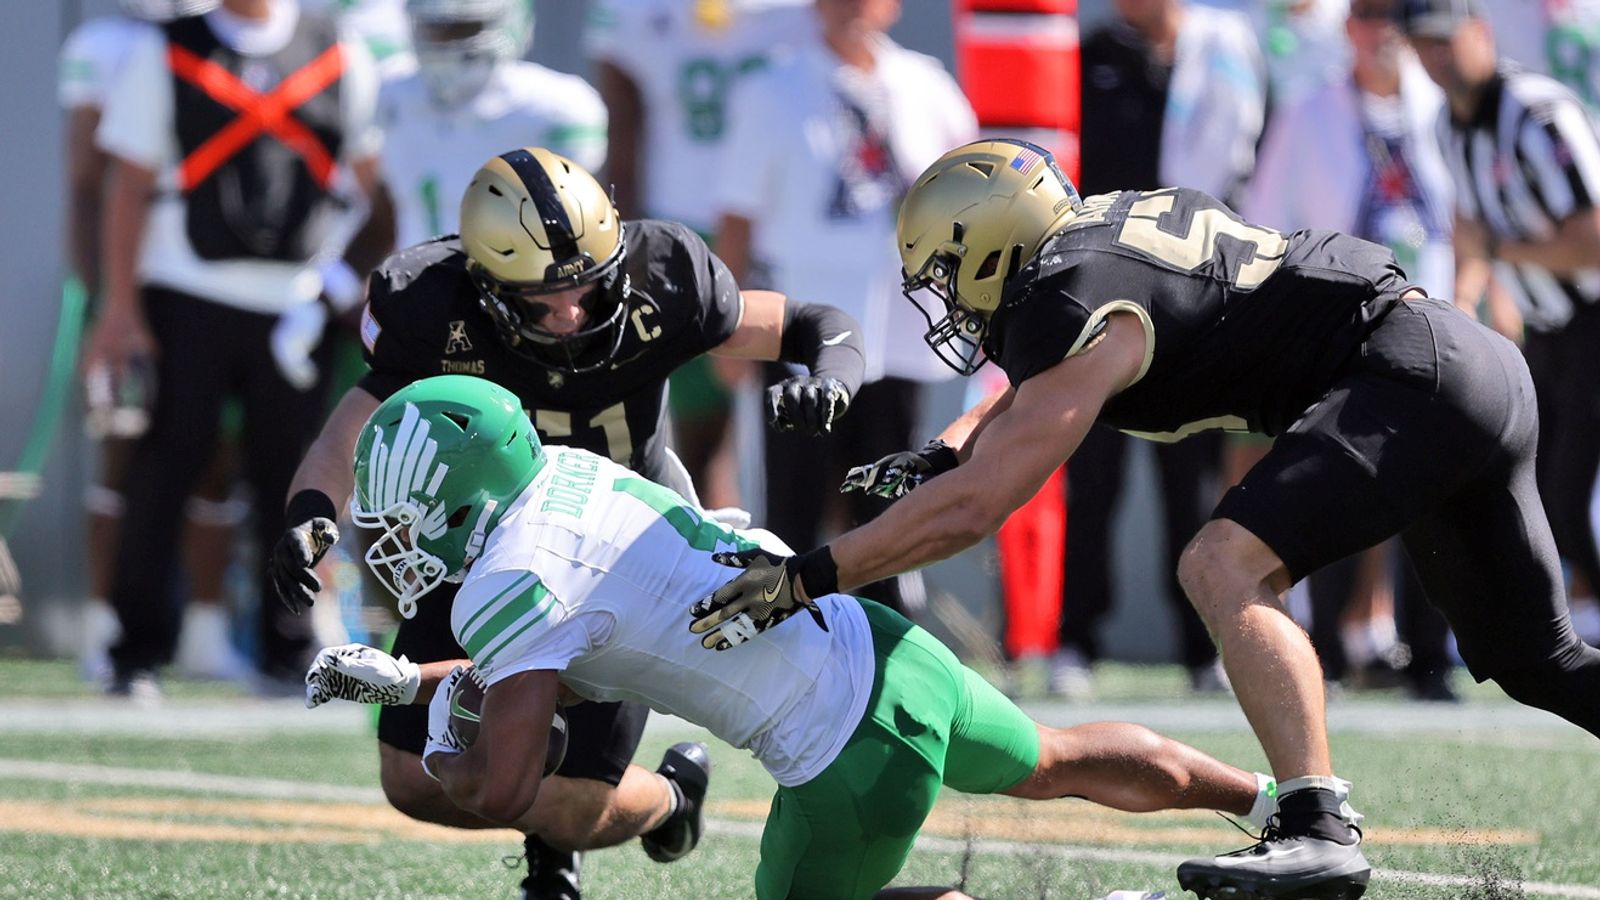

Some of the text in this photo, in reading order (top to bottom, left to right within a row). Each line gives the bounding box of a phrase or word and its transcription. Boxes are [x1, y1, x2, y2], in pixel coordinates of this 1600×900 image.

[1118, 187, 1289, 288] 5
[558, 259, 584, 279] ARMY
[631, 304, 662, 342] C
[441, 360, 485, 374] THOMAS
[524, 401, 632, 469] 1
